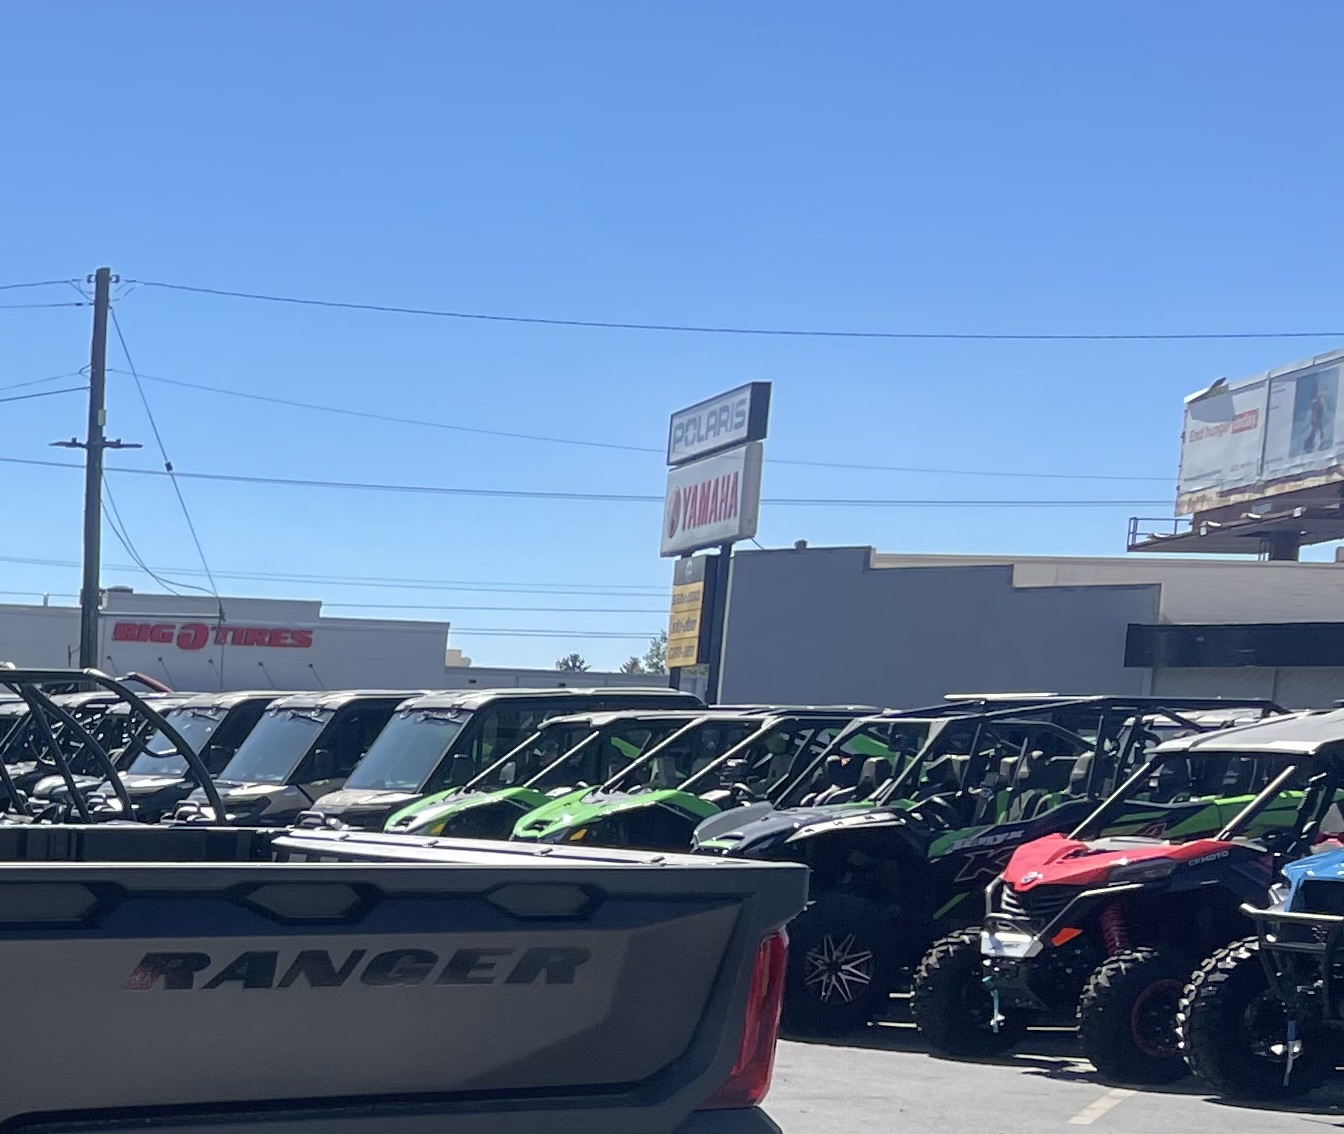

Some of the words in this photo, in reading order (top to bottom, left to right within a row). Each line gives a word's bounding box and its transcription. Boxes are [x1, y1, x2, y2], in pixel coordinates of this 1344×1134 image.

[672, 398, 747, 452] POLARIS
[681, 471, 739, 531] YAMAHA
[112, 622, 176, 643] BIG
[211, 626, 314, 648] TIRES
[123, 946, 593, 991] RANGER
